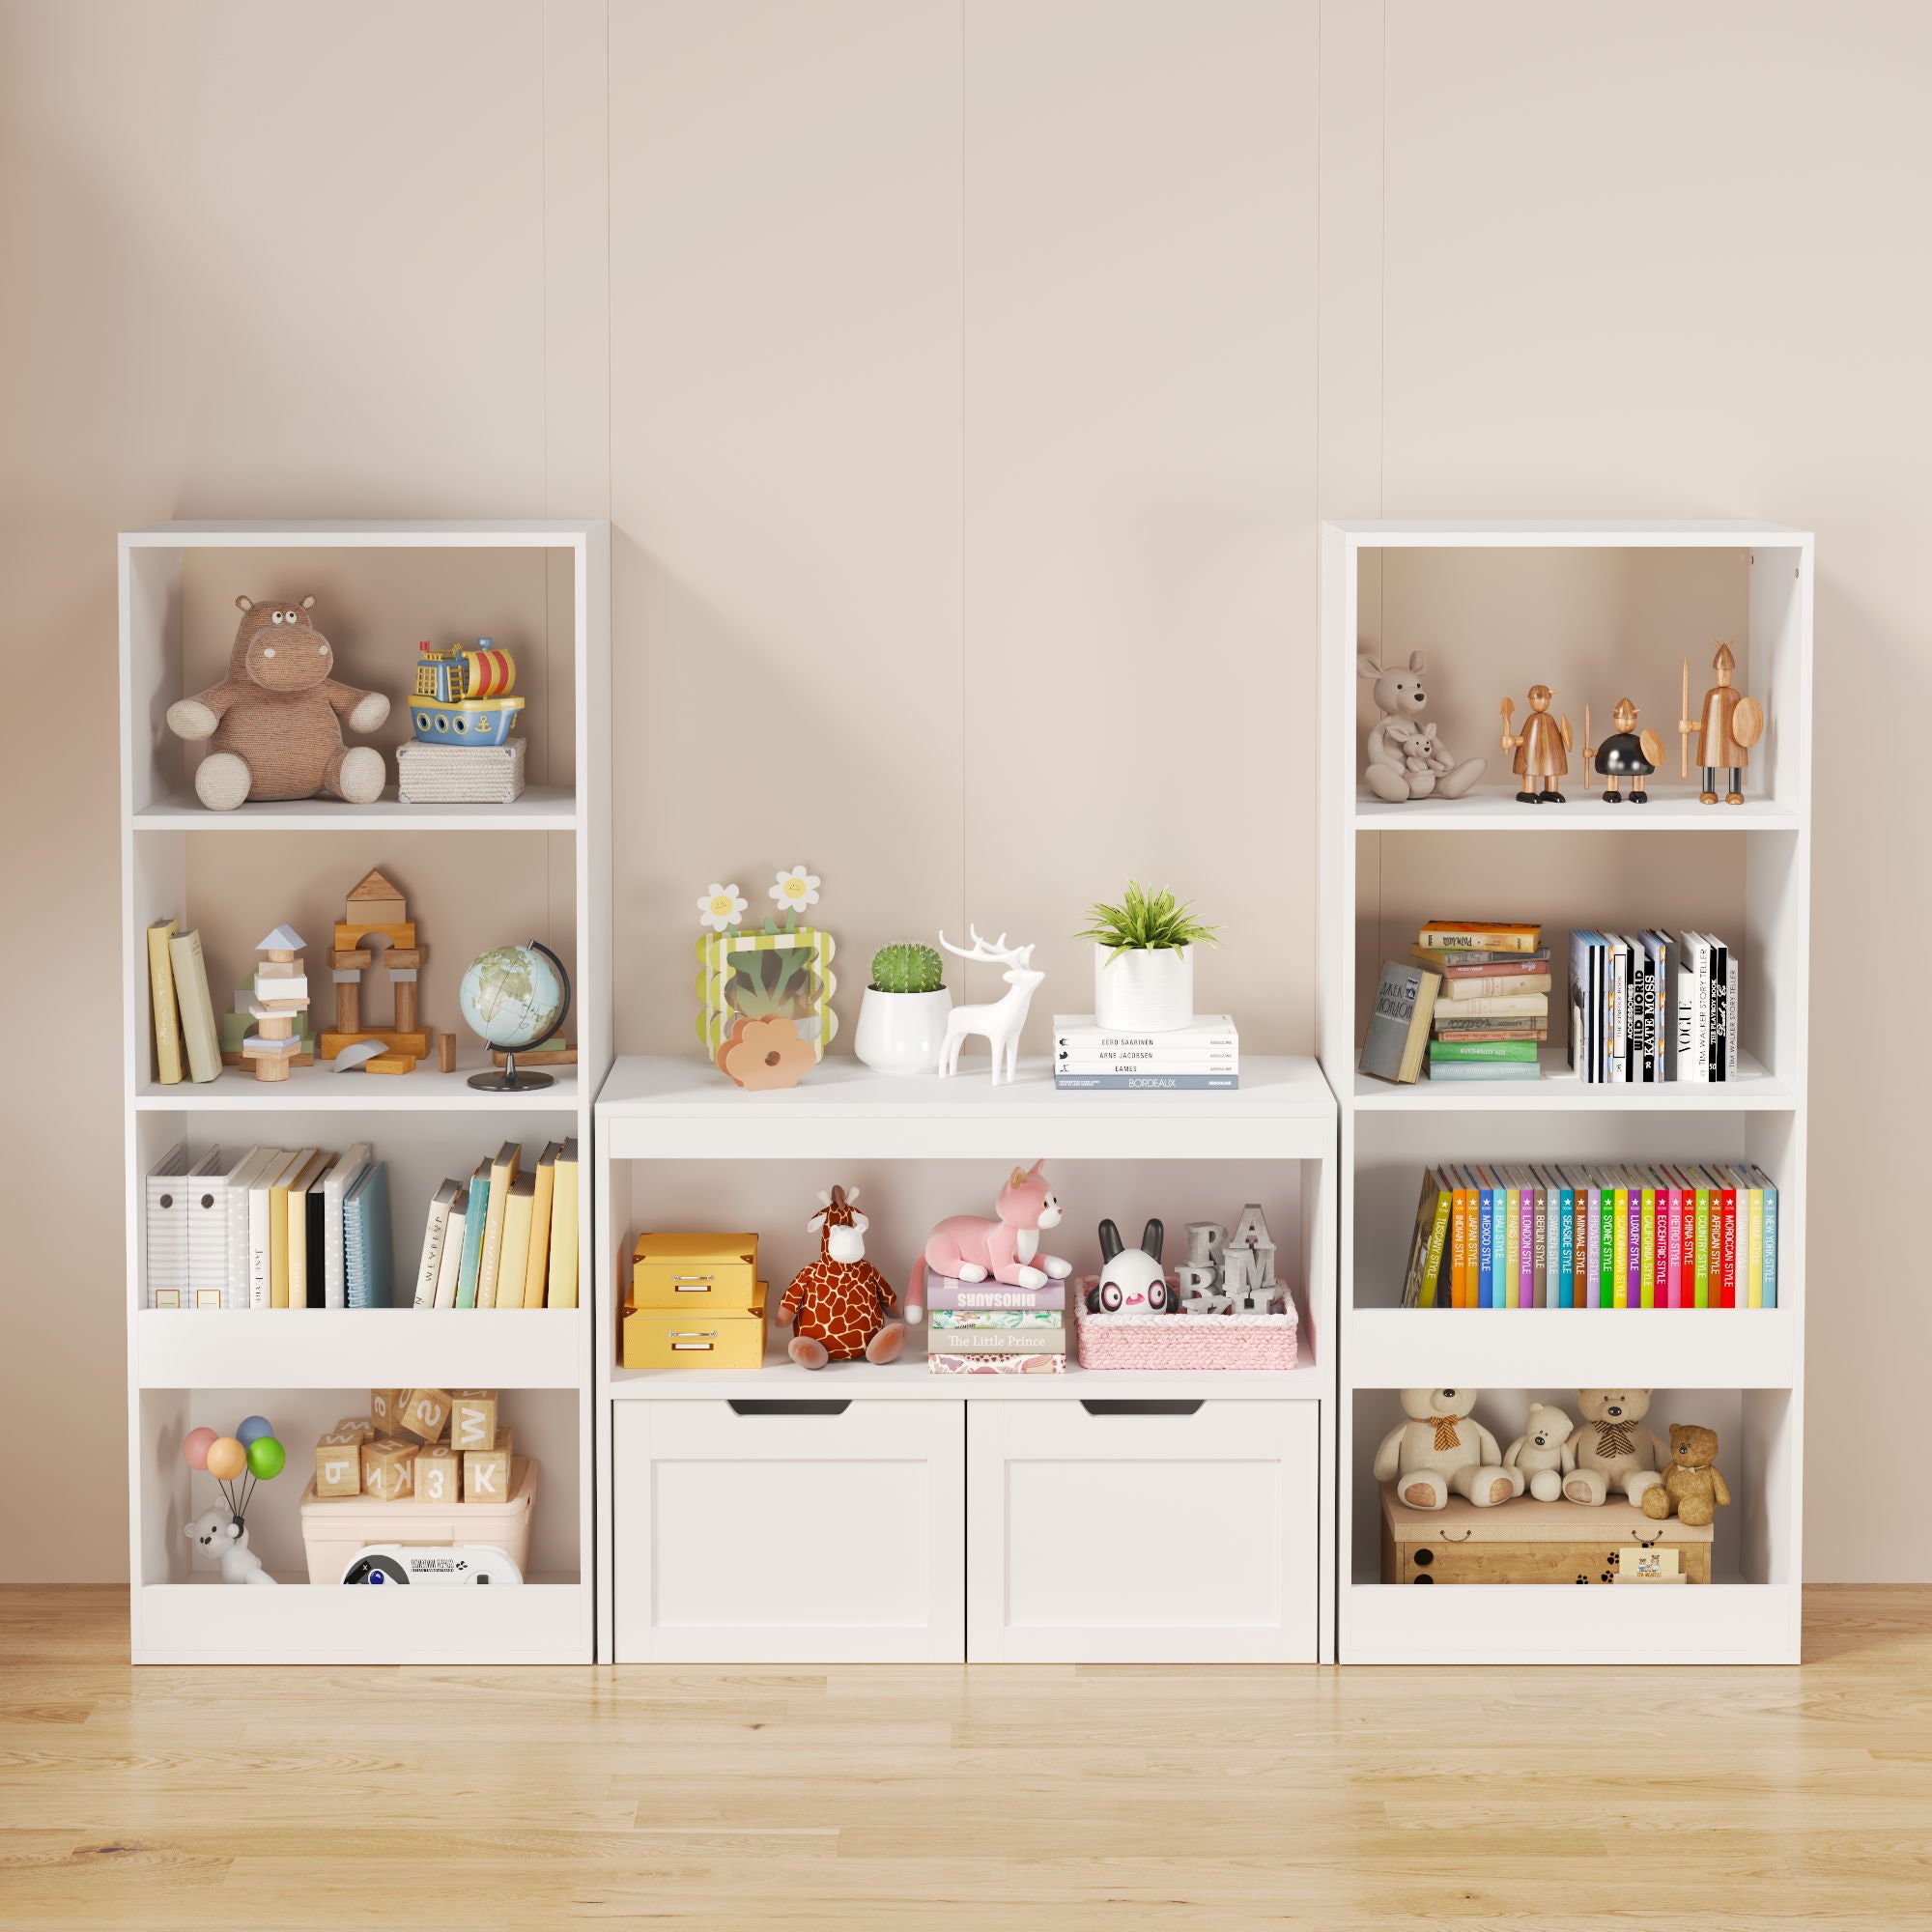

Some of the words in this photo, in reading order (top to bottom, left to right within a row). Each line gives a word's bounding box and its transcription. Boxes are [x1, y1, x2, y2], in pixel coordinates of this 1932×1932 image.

[1645, 975, 1655, 1014] MOSS
[1644, 1018, 1654, 1057] KATE
[1679, 1001, 1691, 1053] VOGUE
[1128, 1078, 1176, 1088] BORDEAUX
[1433, 1217, 1446, 1253] TUSCANY
[1455, 1215, 1463, 1241] INDIAN
[1468, 1215, 1477, 1240] JAPAN
[1482, 1215, 1491, 1245] MEXICO
[1495, 1215, 1504, 1233] BALI
[1509, 1215, 1518, 1238] PARIS
[1522, 1215, 1531, 1248] LONDON
[1536, 1215, 1545, 1242] BERLIN
[1549, 1215, 1558, 1248] SWEDEN
[1563, 1215, 1572, 1247] SEASIDE
[1577, 1215, 1585, 1248] MINIMAL
[1590, 1215, 1599, 1257] PROVENCE
[1604, 1215, 1612, 1246] SYDNEY
[1631, 1215, 1639, 1245] LUXURY
[1671, 1215, 1680, 1241] RETRO
[1685, 1215, 1693, 1239] CHINA
[1698, 1215, 1707, 1252] COUNTRY
[1712, 1215, 1720, 1248] AFRICAN
[1766, 1215, 1775, 1233] NEW
[1495, 1235, 1504, 1259] STYLE
[1617, 1215, 1626, 1272] SCANDINAVIAN
[1644, 1215, 1653, 1261] CALIFORNIA
[1658, 1215, 1666, 1259] ECCENTRIC
[1725, 1215, 1734, 1261] MOROCCAN
[1766, 1236, 1775, 1257] YORK
[1455, 1244, 1463, 1267] STYLE
[1468, 1243, 1477, 1266] STYLE
[1482, 1247, 1491, 1271] STYLE
[1509, 1240, 1518, 1264] STYLE
[1522, 1251, 1531, 1274] STYLE
[1536, 1245, 1545, 1268] STYLE
[1549, 1251, 1558, 1274] STYLE
[1563, 1250, 1572, 1273] STYLE
[1577, 1251, 1585, 1275] STYLE
[1604, 1248, 1612, 1271] STYLE
[1631, 1247, 1639, 1271] STYLE
[1671, 1243, 1680, 1267] STYLE
[1685, 1241, 1693, 1264] STYLE
[1712, 1251, 1720, 1274] STYLE
[1428, 1255, 1438, 1279] STYLE
[1590, 1259, 1599, 1283] STYLE
[1644, 1263, 1653, 1287] STYLE
[1658, 1261, 1666, 1284] STYLE
[1698, 1254, 1707, 1278] STYLE
[1725, 1264, 1734, 1287] STYLE
[1766, 1259, 1775, 1283] STYLE
[1617, 1274, 1626, 1298] STYLE
[957, 1293, 1037, 1307] DINOSAURS
[948, 1335, 970, 1347] The
[974, 1335, 1006, 1347] Little
[1008, 1335, 1046, 1347] Prince
